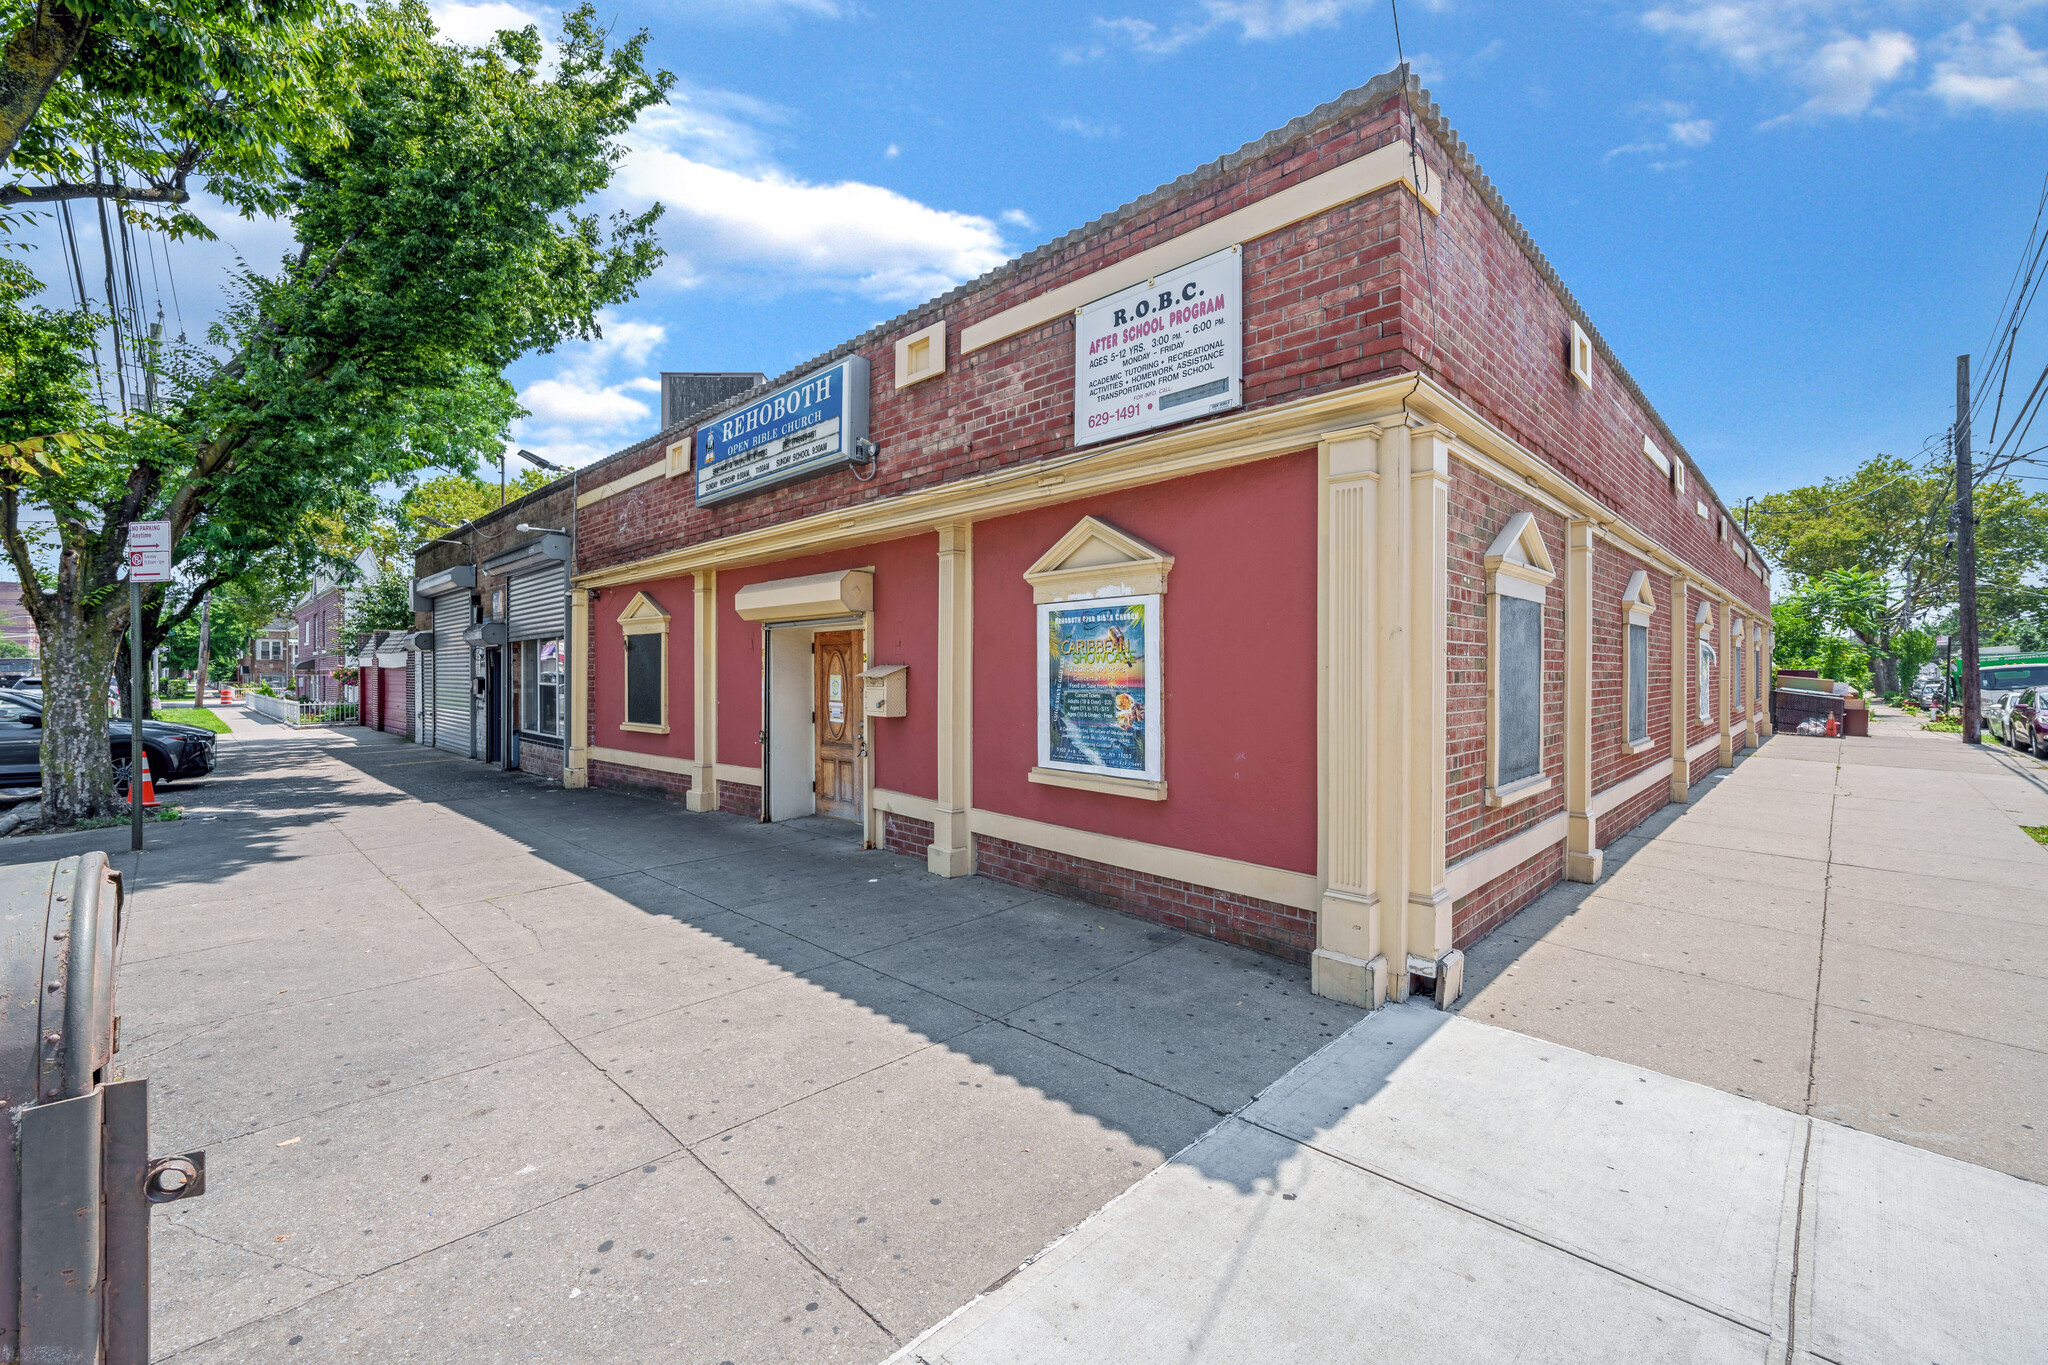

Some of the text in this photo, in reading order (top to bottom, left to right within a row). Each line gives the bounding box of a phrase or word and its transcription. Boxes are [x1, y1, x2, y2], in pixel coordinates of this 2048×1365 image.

[1089, 294, 1225, 355] AFTER SCHOOL PROGRAM
[1113, 282, 1204, 327] R.O.B.C.
[1089, 355, 1113, 369] AGES
[1111, 351, 1126, 362] 5-12
[1129, 343, 1146, 356] YRS.
[1152, 335, 1169, 348] 3:00
[1172, 332, 1182, 341] PM.
[1193, 320, 1211, 333] 6:00
[1215, 318, 1225, 326] PM.
[1089, 340, 1224, 388] ACADEMIC TUTORING RECREATIONAL
[1122, 353, 1150, 367] MONDAY
[1160, 341, 1185, 354] FRIDAY
[1089, 350, 1224, 396] ACTIVITIES HOMEWORK ASSISTANCE
[1097, 363, 1214, 402] TRANSPORTATION FROM SCHOOL
[721, 375, 832, 442] REHOBOTH
[1088, 403, 1140, 429] 629-1491
[727, 439, 749, 456] OPEN
[752, 428, 778, 446] BIBLE
[781, 410, 822, 434] CHURCH
[776, 454, 791, 467] SUNDAY
[793, 447, 810, 461] SCHOOL
[1061, 638, 1129, 655] CARIBBEAN
[1072, 650, 1136, 664] SHOWCASE
